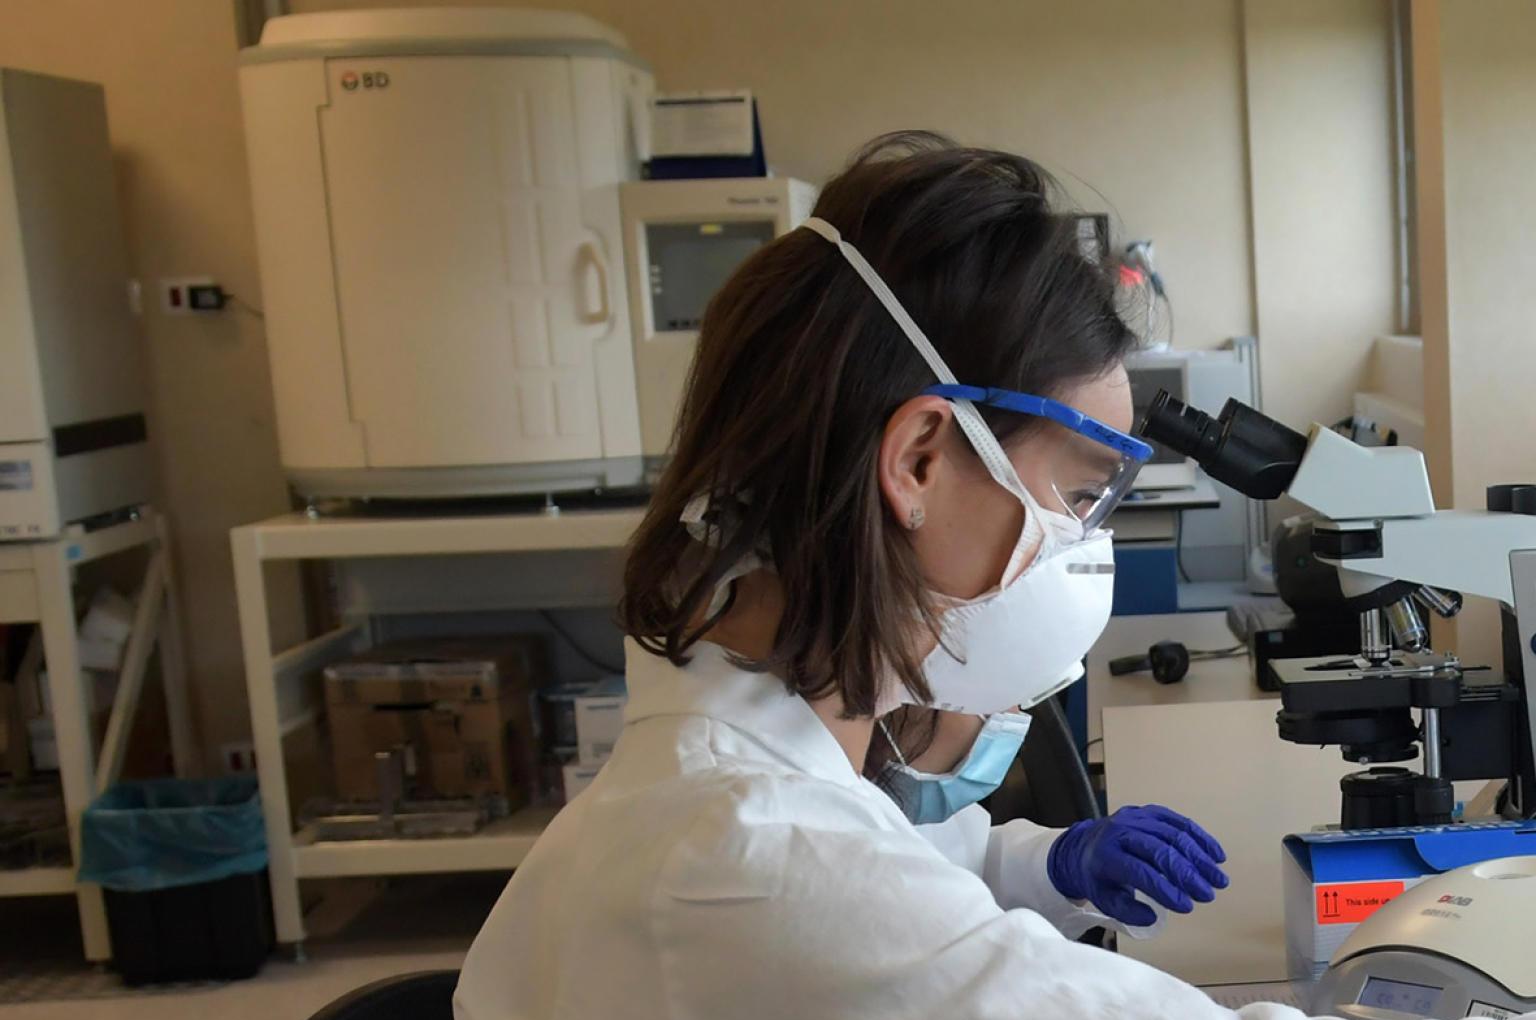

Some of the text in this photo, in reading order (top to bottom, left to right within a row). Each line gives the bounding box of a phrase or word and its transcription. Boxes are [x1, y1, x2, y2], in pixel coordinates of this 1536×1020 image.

[362, 71, 390, 89] BD
[1346, 897, 1362, 906] This
[1363, 897, 1379, 906] side
